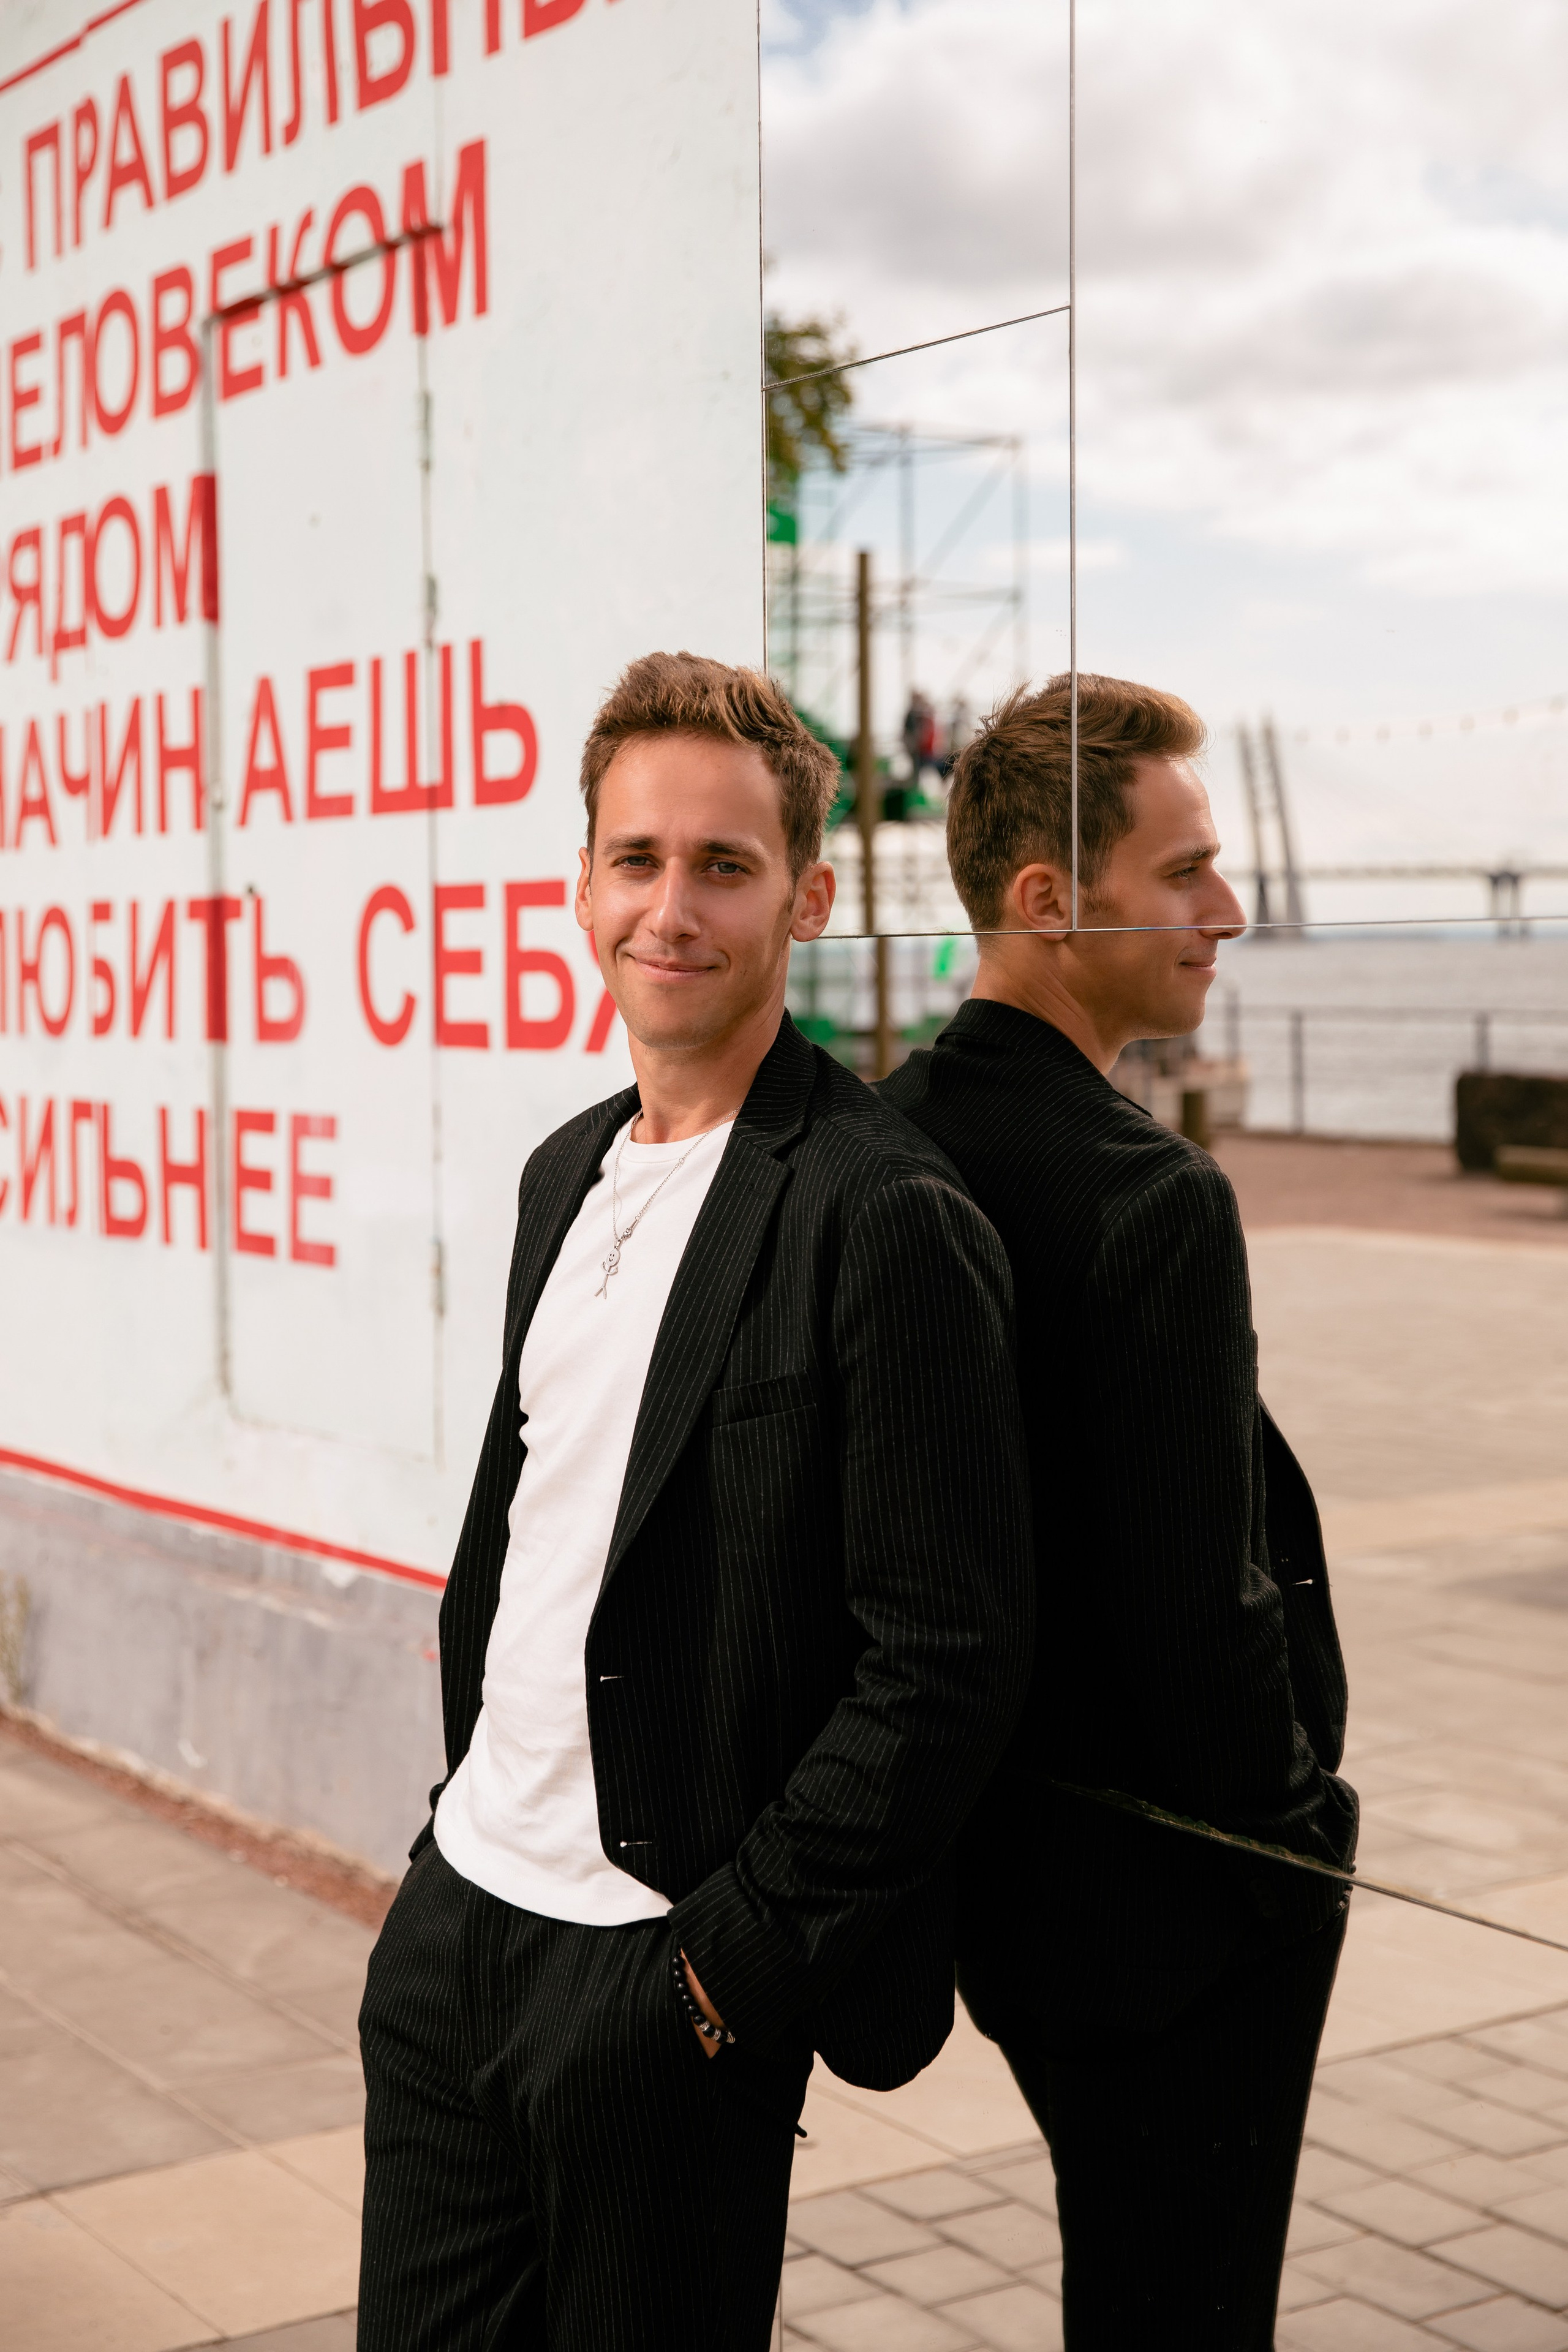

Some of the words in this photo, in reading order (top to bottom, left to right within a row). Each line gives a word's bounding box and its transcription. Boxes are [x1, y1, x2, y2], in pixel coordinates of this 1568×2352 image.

[0, 137, 489, 473] ЕЛОВЕКОМ
[0, 472, 221, 682] ЯДОМ
[0, 638, 540, 850] АЧИНАЕШЬ
